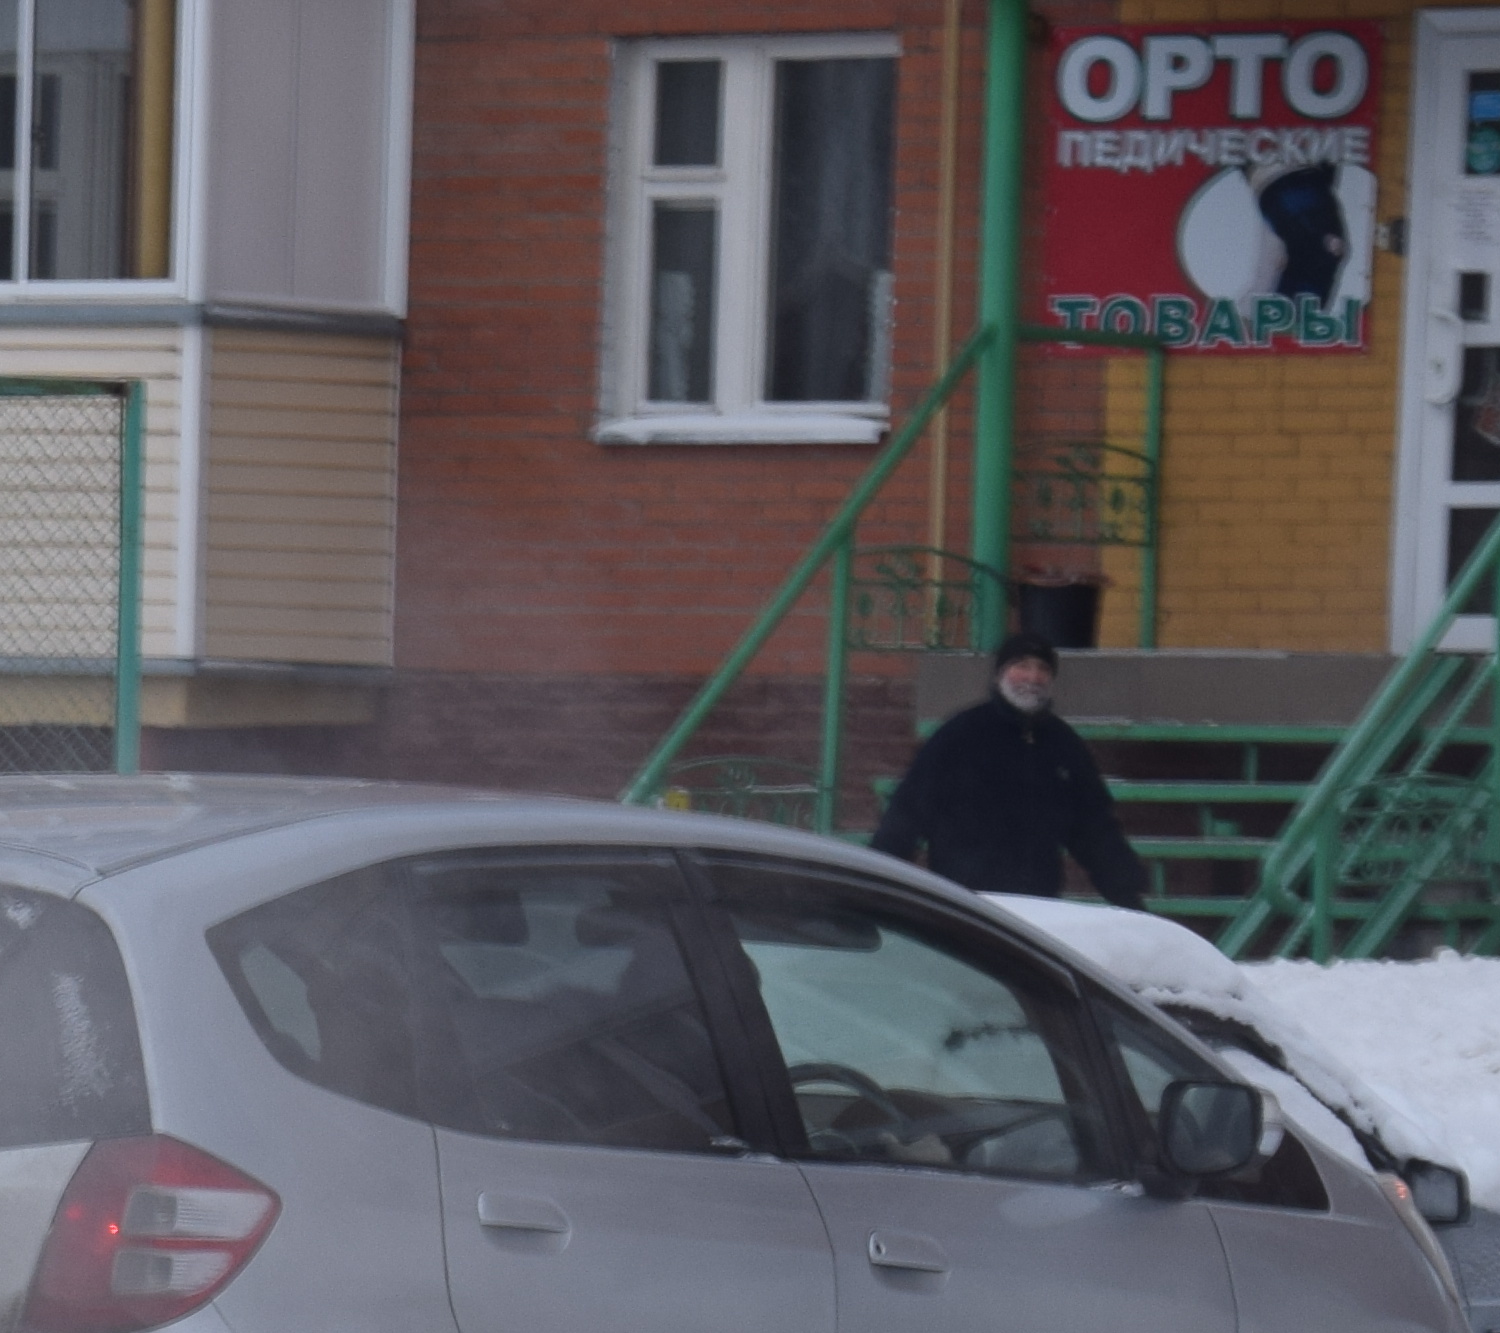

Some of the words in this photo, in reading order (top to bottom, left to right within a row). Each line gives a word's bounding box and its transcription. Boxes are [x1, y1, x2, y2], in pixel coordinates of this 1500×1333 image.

[1056, 31, 1370, 123] ОРТО
[1056, 125, 1372, 173] ПЕДИЧЕСКИЕ
[1050, 294, 1366, 349] ТОВАРЫ
